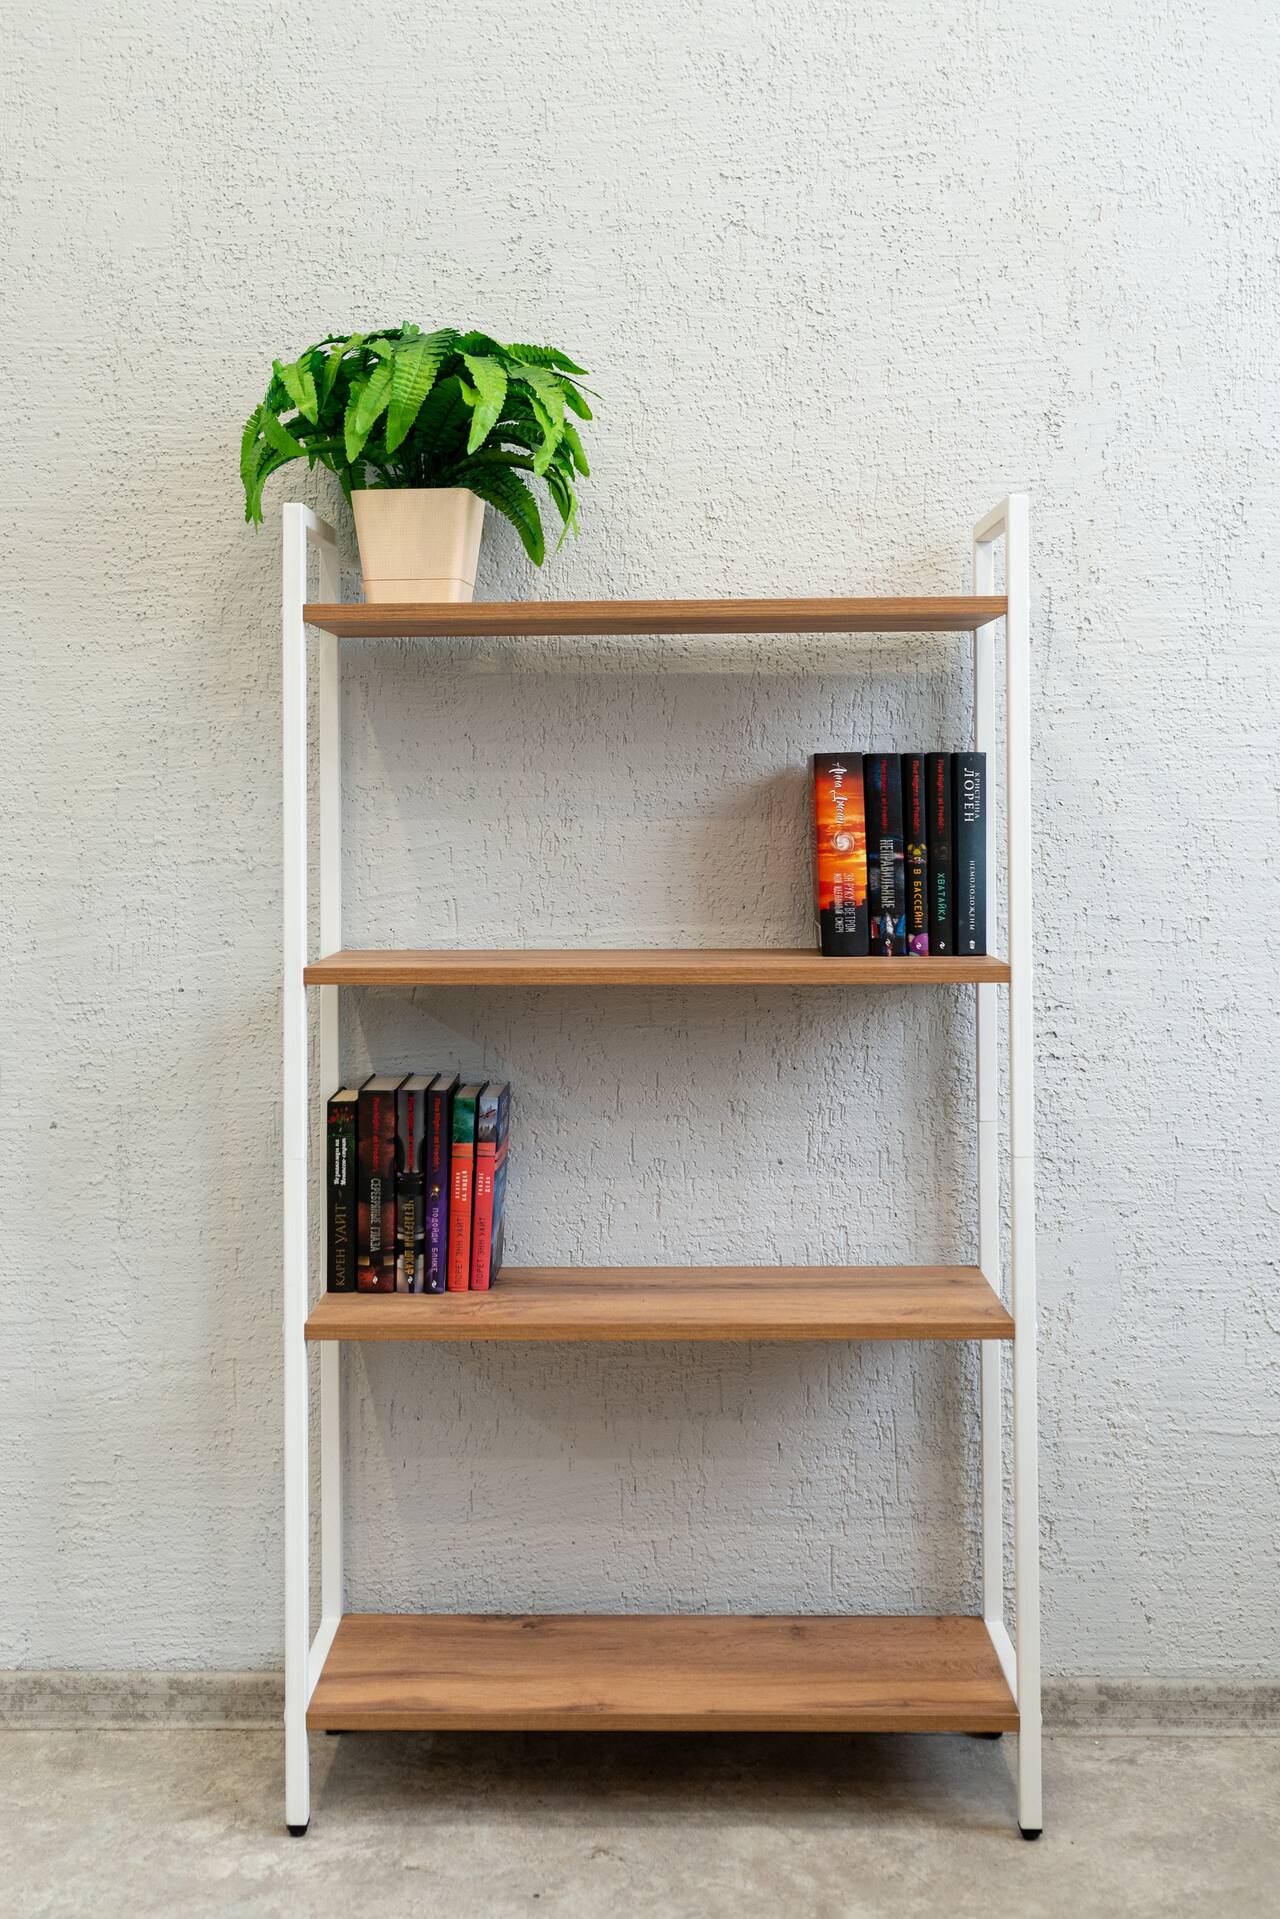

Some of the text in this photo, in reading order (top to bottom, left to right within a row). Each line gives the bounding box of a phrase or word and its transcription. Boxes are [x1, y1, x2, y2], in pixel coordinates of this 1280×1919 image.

[829, 762, 848, 788] Анна
[964, 767, 975, 822] ЛОРЕН
[843, 872, 855, 882] ЗА
[844, 883, 855, 900] РУКУ
[880, 839, 895, 909] НЕПРАВИЛЬНЫЕ
[937, 872, 948, 921] ХВАТАЙКА
[834, 916, 844, 933] СМЕРЧ
[845, 907, 856, 933] ВЕТРОМ
[913, 880, 924, 928] БАССЕЙН!
[370, 1178, 381, 1252] СЕРЕБРЯНЫЕ ГЛАЗА
[334, 1203, 348, 1287] КАРЕН УАЙТ
[431, 1207, 440, 1273] ПОДОЙДИ БЛИЖЕ
